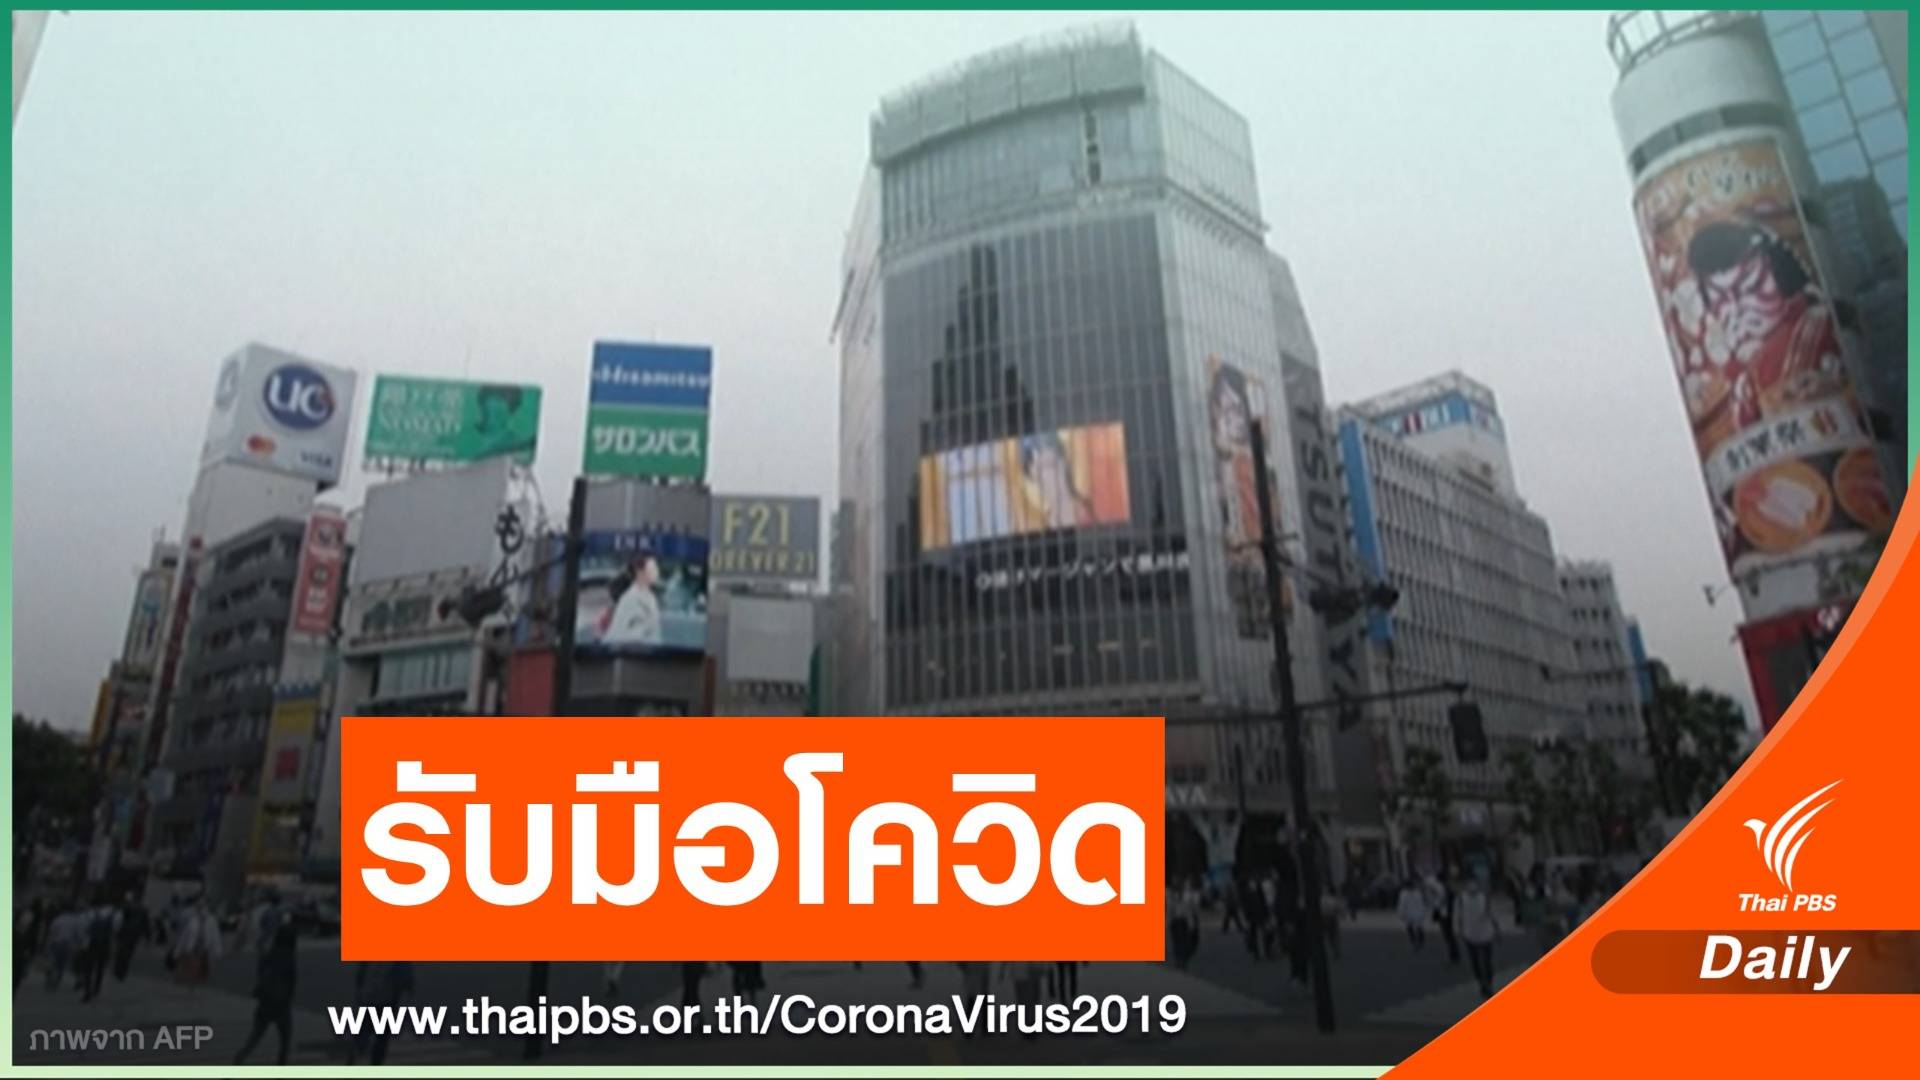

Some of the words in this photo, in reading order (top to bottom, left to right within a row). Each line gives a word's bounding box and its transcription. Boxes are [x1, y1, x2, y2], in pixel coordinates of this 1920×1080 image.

[268, 374, 330, 421] UC
[592, 426, 700, 457] サロンパス
[723, 502, 791, 546] F21
[710, 550, 790, 574] OREVER
[1295, 400, 1362, 733] TSUTYA
